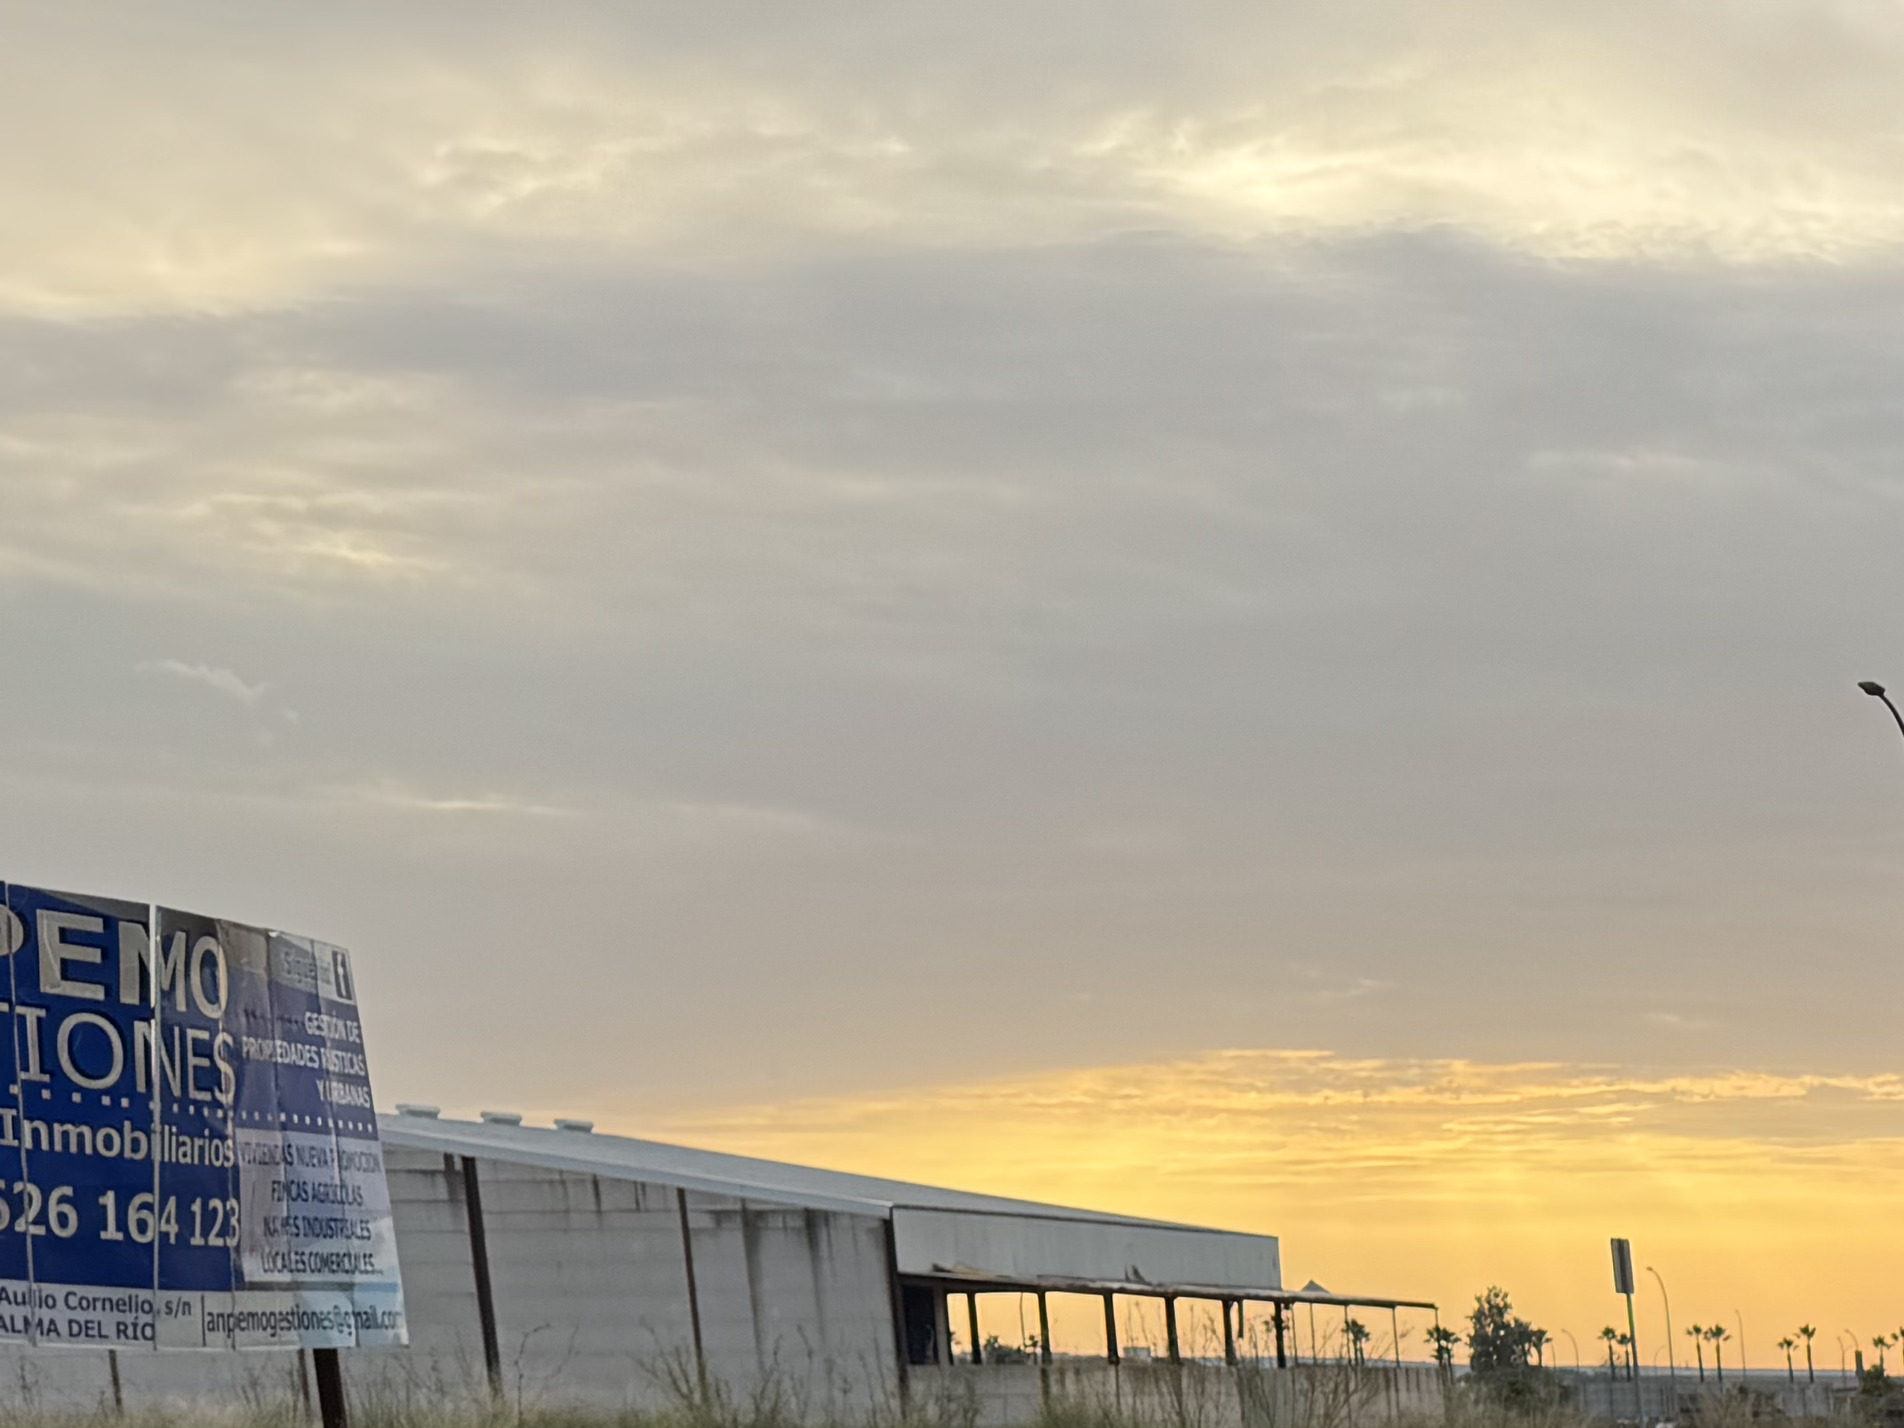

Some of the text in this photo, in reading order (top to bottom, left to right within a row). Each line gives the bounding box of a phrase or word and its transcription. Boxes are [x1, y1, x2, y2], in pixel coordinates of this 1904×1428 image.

[0, 1002, 236, 1106] IONES
[98, 1190, 179, 1246] 164
[189, 1197, 241, 1248] 123
[68, 1318, 109, 1339] DEL
[116, 1315, 155, 1342] RÍO
[165, 1296, 192, 1319] s/n
